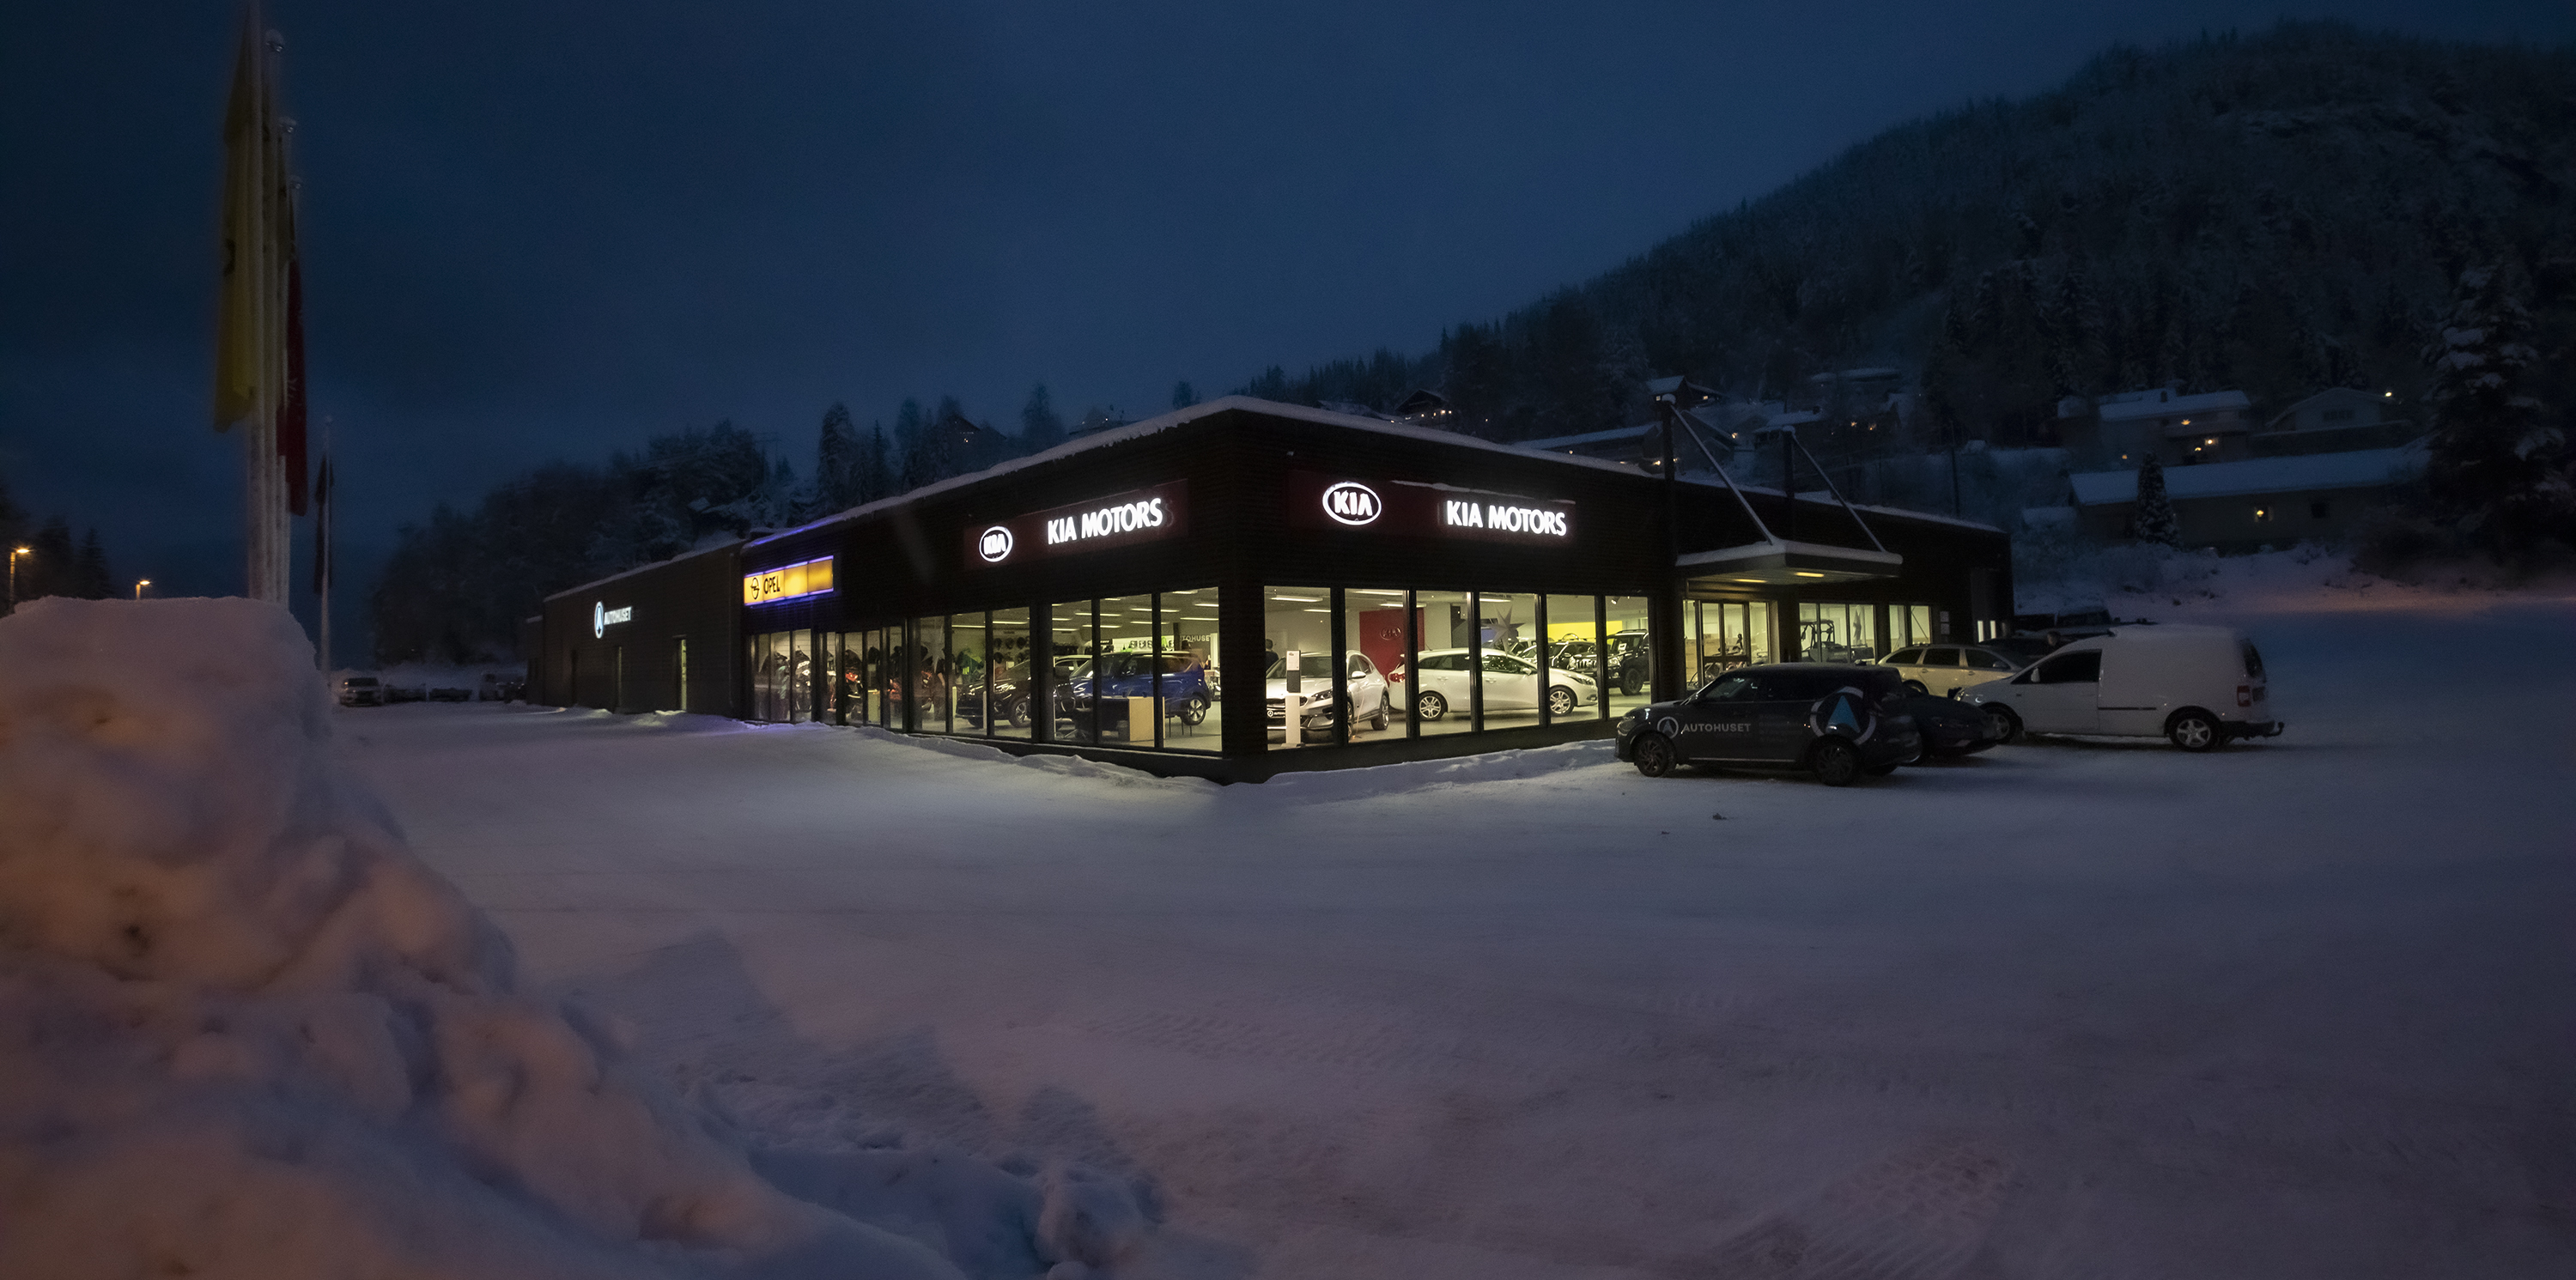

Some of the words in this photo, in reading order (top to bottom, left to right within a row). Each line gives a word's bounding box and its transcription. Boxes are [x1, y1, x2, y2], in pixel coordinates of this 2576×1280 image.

[1334, 490, 1373, 517] KIA
[1048, 517, 1077, 545] KIA
[1082, 498, 1163, 539] MOTORS
[1446, 500, 1484, 528] KIA
[1488, 505, 1567, 537] MOTORS
[983, 533, 1006, 555] KIA
[763, 575, 781, 595] OPEL
[1681, 723, 1752, 733] AUTOHUSET
